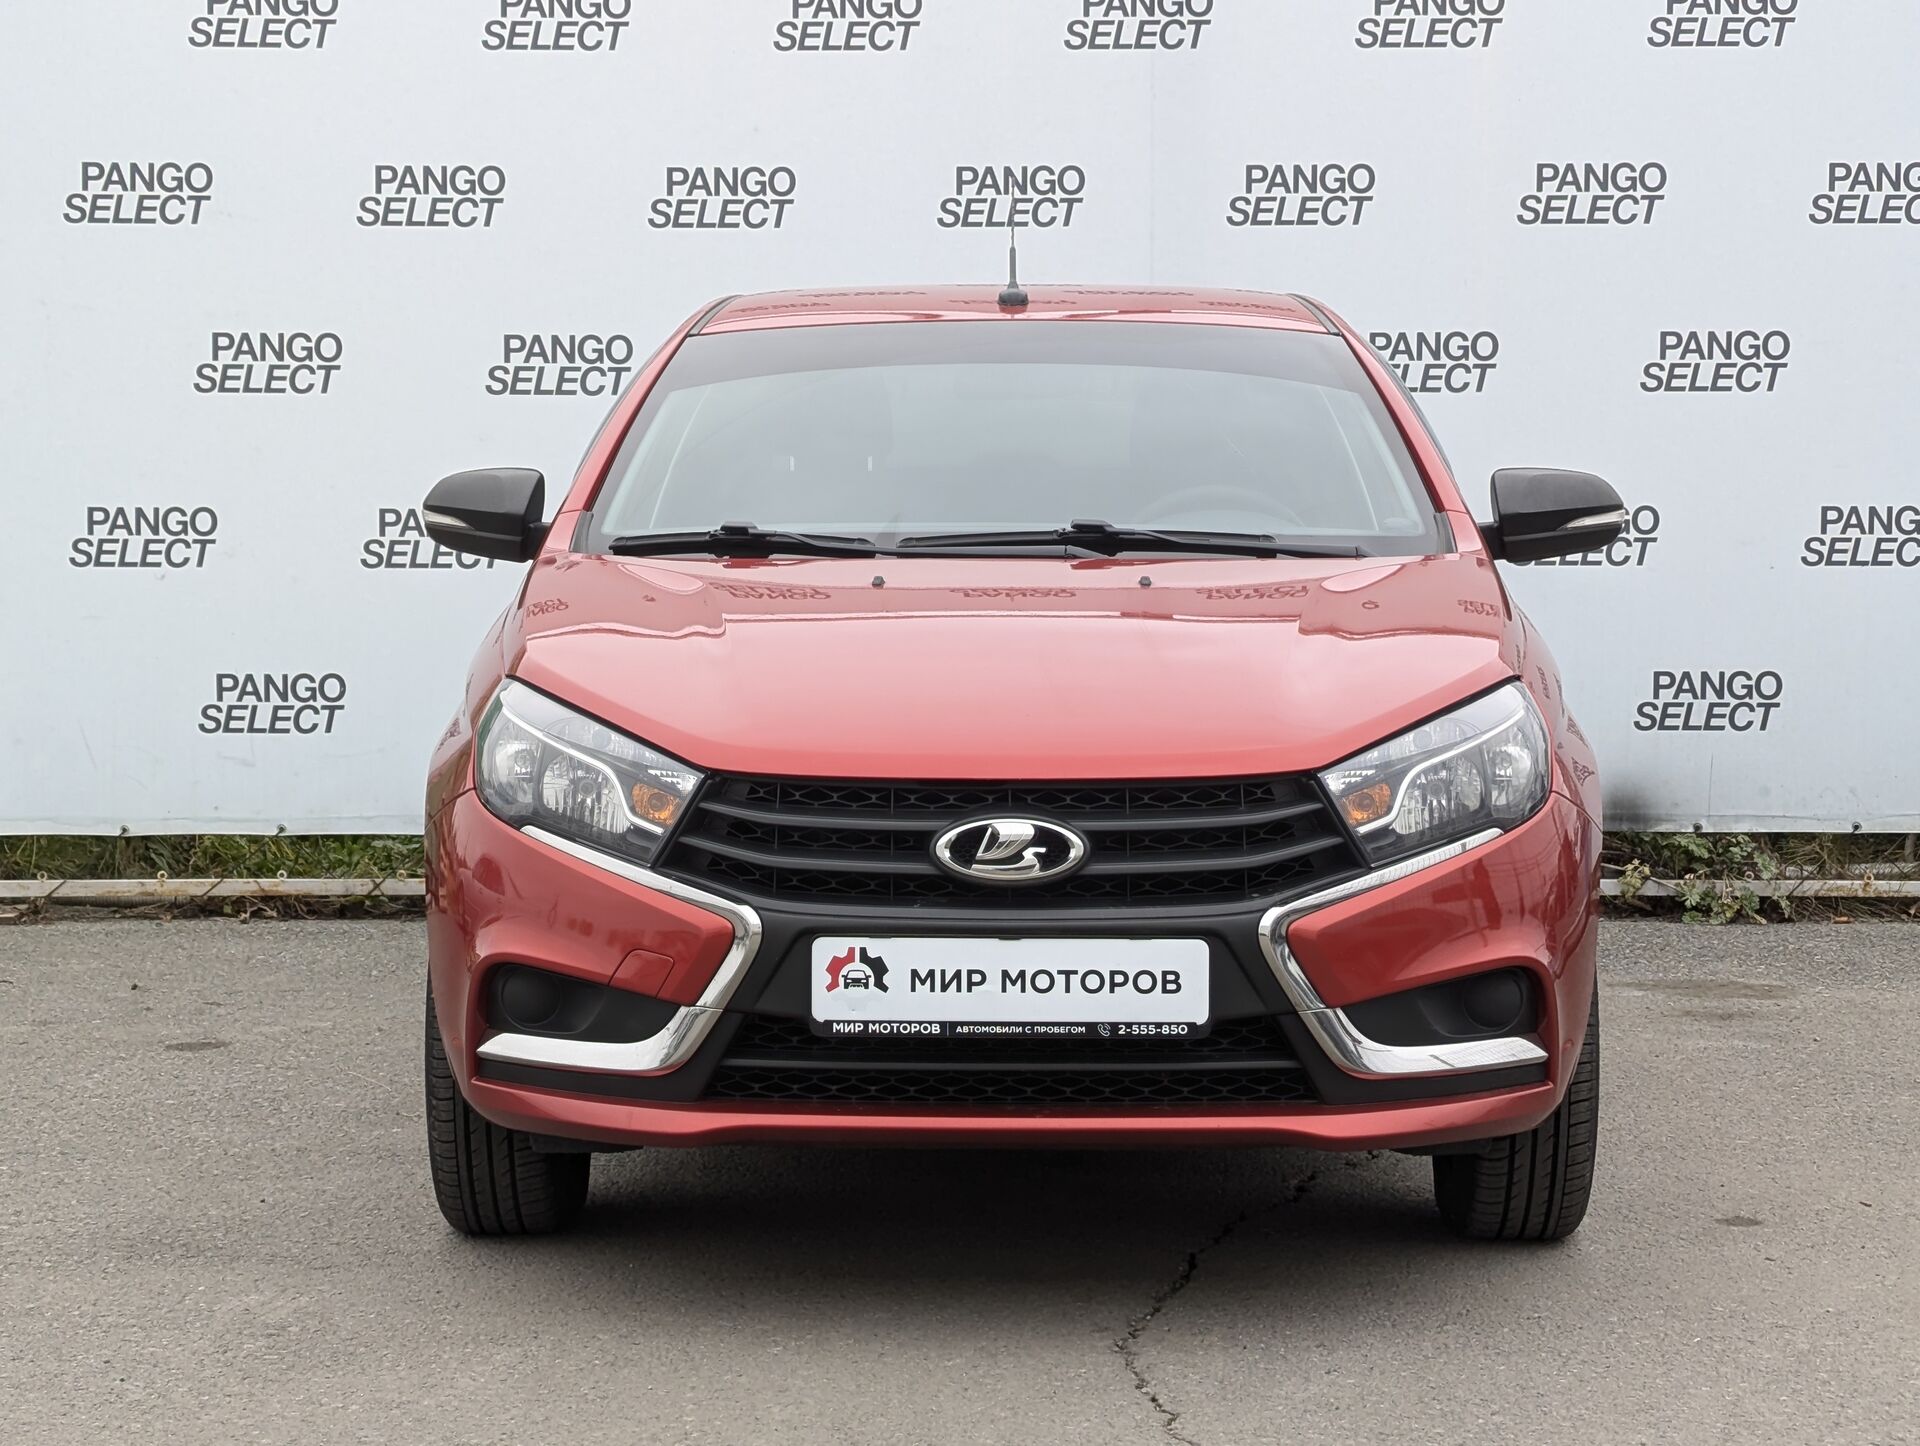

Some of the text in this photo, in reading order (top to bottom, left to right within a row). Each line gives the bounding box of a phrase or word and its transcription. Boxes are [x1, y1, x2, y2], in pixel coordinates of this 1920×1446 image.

[189, 18, 336, 48] SELECT
[482, 21, 629, 50] SELECT
[774, 21, 920, 51] SELECT
[1064, 20, 1211, 49] SELECT
[1356, 18, 1502, 48] SELECT
[1648, 17, 1795, 47] SELECT
[82, 162, 212, 192] PANGO
[376, 166, 505, 195] PANGO
[667, 167, 795, 196] PANGO
[957, 166, 1085, 195] PANGO
[1246, 164, 1375, 193] PANGO
[1537, 163, 1666, 192] PANGO
[1829, 162, 1920, 192] PANG
[64, 194, 211, 224] SELECT
[357, 197, 503, 227] SELECT
[648, 199, 794, 228] SELECT
[938, 196, 1083, 227] SELECT
[1227, 196, 1373, 226] SELECT
[1517, 195, 1664, 224] SELECT
[1809, 194, 1920, 224] SELEC
[213, 333, 342, 362] PANGO
[504, 335, 633, 364] PANGO
[1660, 331, 1790, 360] PANGO
[194, 364, 340, 393] SELECT
[486, 366, 631, 396] SELECT
[1391, 363, 1496, 392] LECT
[1640, 362, 1788, 392] SELECT
[88, 507, 217, 536] PANGO
[1821, 506, 1920, 535] PANG
[70, 538, 216, 568] SELECT
[1801, 537, 1920, 567] SELEC
[217, 673, 346, 702] PANGO
[1653, 671, 1782, 700] PANGO
[199, 704, 344, 734] SELECT
[1634, 702, 1780, 731] SELECT
[910, 969, 1182, 994] МИР МОТОРОВ
[832, 1022, 941, 1034] МИР МОТОРОВ
[955, 1025, 1086, 1034] АВТОМОБИЛИ С ПРОБЕГОМ
[1117, 1024, 1188, 1035] 2-555-850
